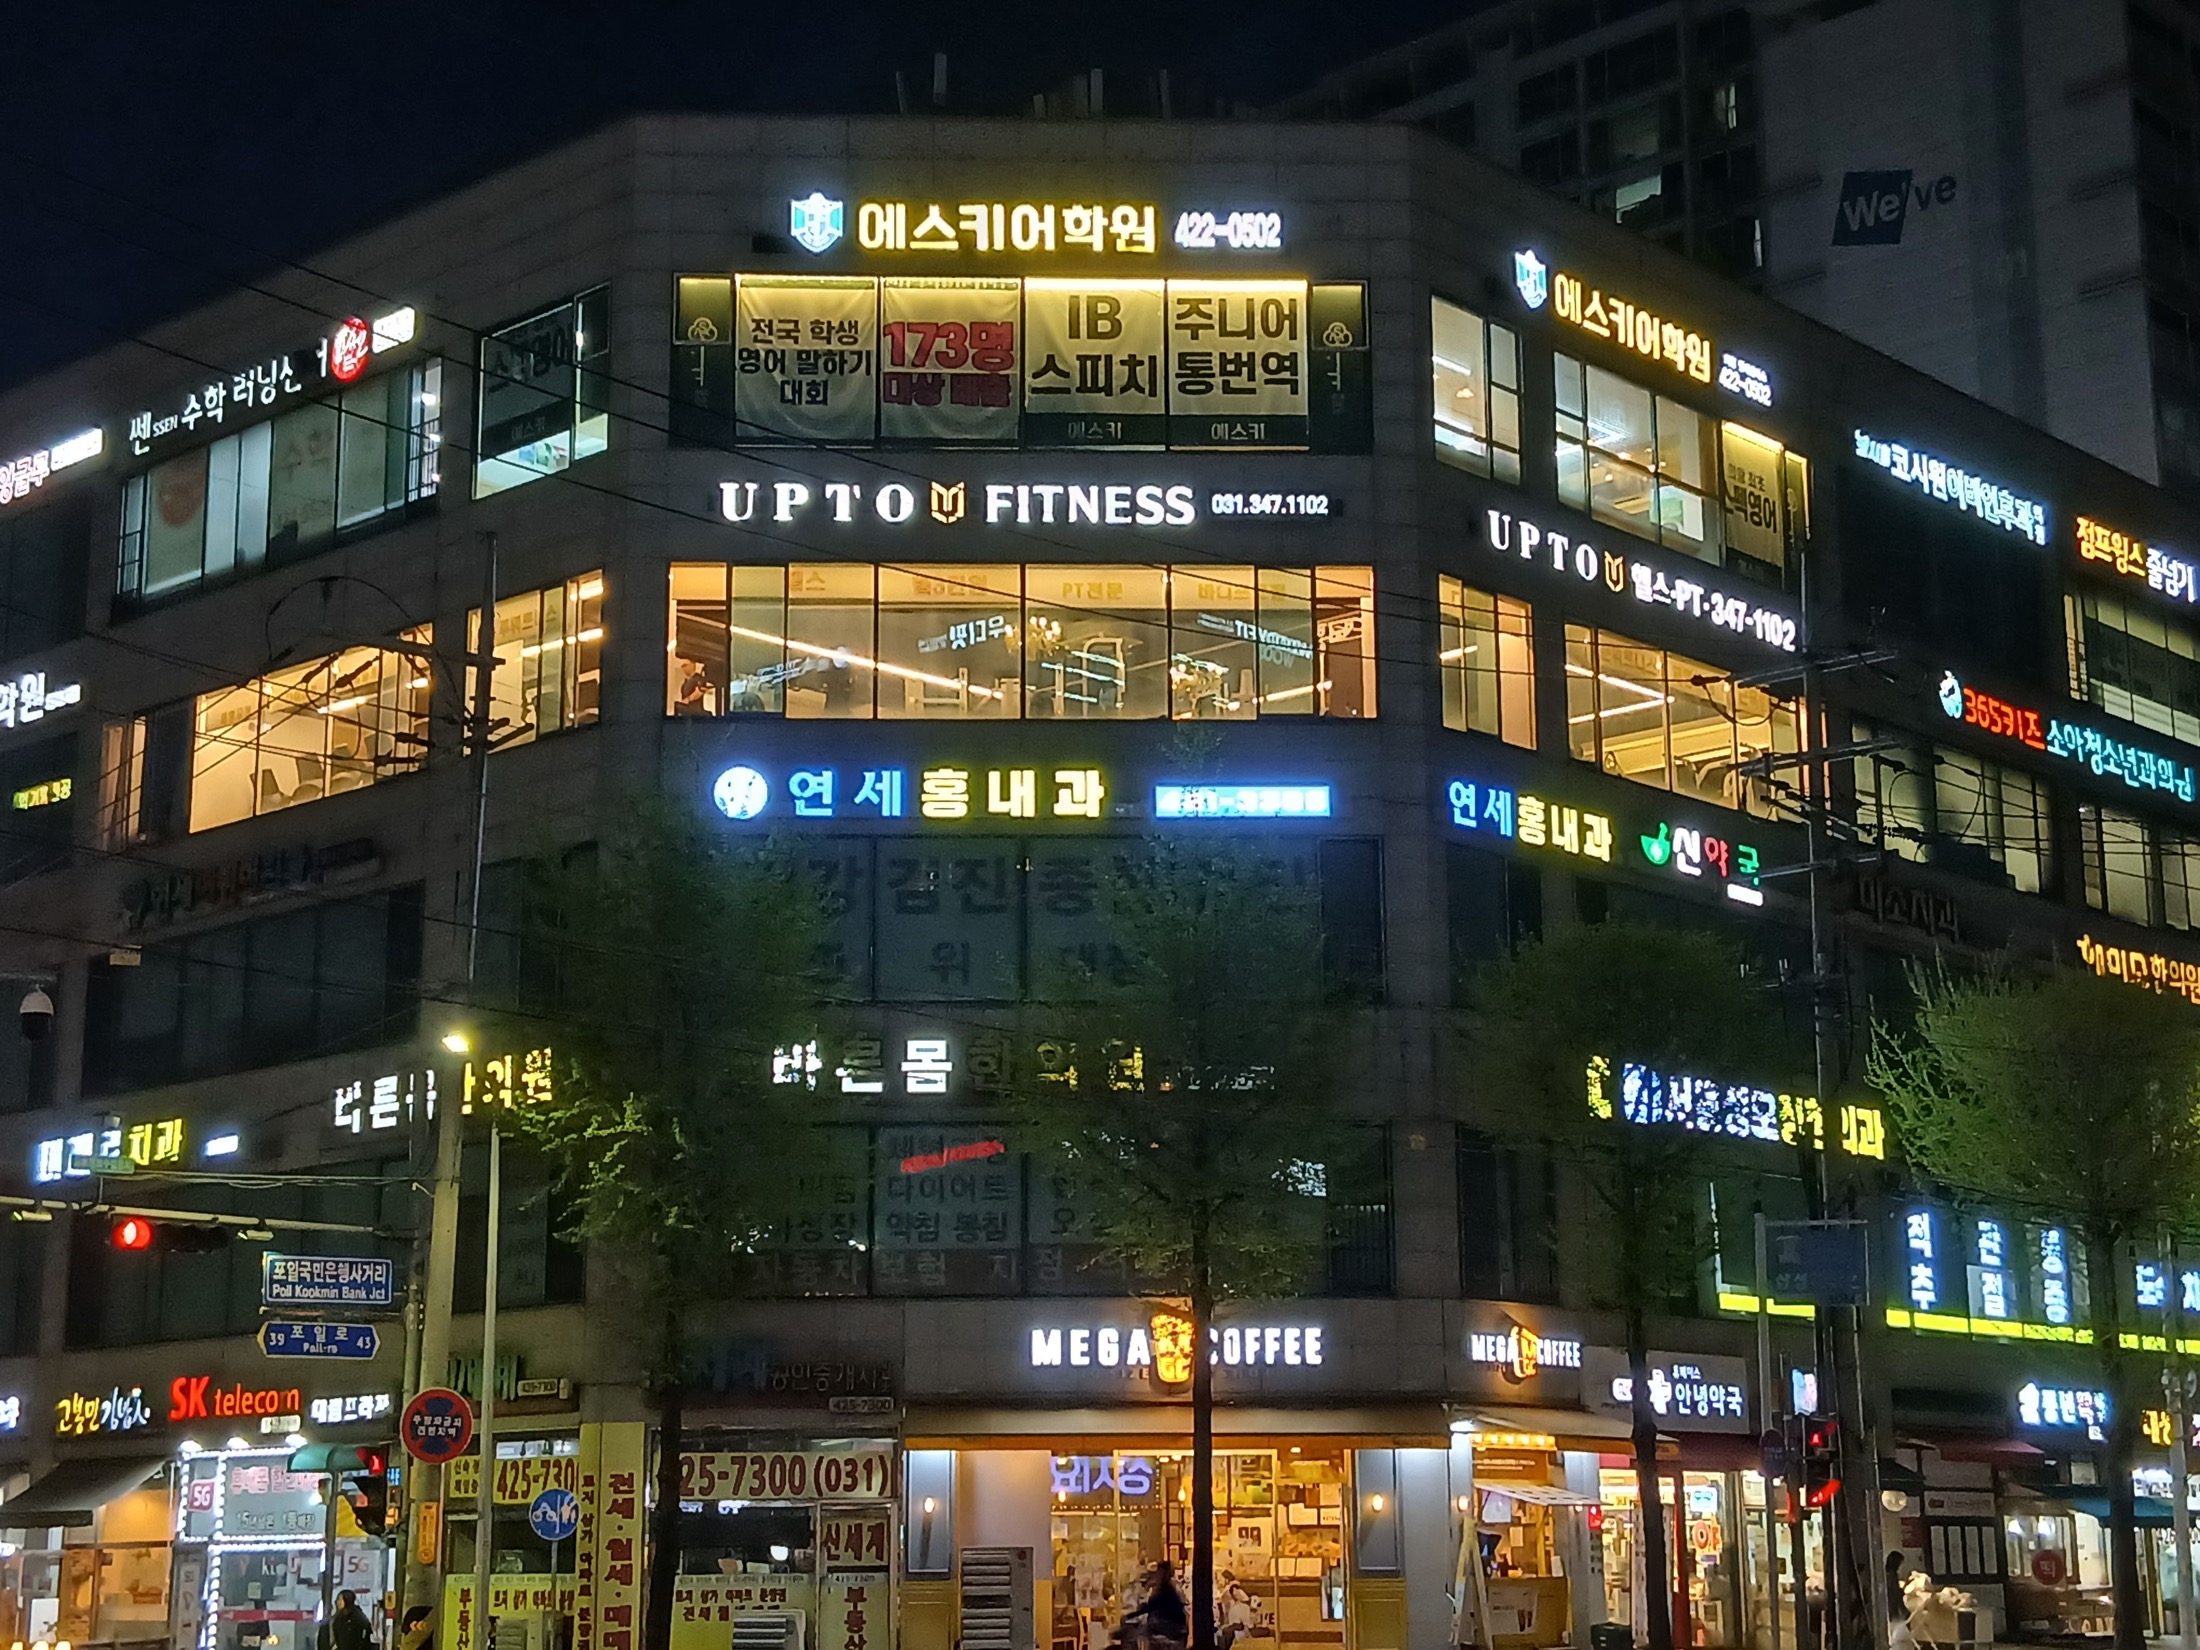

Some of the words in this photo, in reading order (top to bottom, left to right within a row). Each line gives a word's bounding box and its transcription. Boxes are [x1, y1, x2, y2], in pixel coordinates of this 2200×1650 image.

[1843, 175, 1957, 232] We've
[857, 201, 1157, 254] 에스키어학원
[1173, 211, 1283, 249] 422-0502
[751, 317, 801, 346] 전국
[809, 318, 860, 345] 학생
[1067, 295, 1124, 341] IB
[1174, 297, 1299, 342] 주니어
[1554, 273, 1711, 384] 에스키어학원
[738, 349, 786, 376] 영어
[796, 348, 872, 377] 말하기
[883, 321, 1015, 372] 173명
[779, 379, 829, 406] 대회
[1029, 353, 1158, 398] 스피치
[1174, 350, 1300, 396] 통번역
[152, 415, 179, 439] SSEN
[181, 382, 226, 431] 수학
[1210, 421, 1266, 441] 에스키
[986, 483, 1197, 525] FITNESS
[1210, 493, 1329, 517] 031.347.1102
[788, 769, 902, 818] 연세
[920, 769, 1106, 818] 홍내과
[1448, 780, 1514, 838] 연세
[1516, 793, 1613, 864] 홍내과
[272, 1260, 387, 1285] 포일국민은행사거리
[294, 1284, 339, 1299] Kookmin
[341, 1286, 367, 1299] Bank
[369, 1287, 386, 1300] Jct
[269, 1332, 285, 1346] 39
[290, 1325, 349, 1342] 포일로
[356, 1336, 371, 1349] 43
[1030, 1328, 1151, 1366] MEGA
[1471, 1334, 1518, 1363] MEGA
[1536, 1338, 1582, 1368] COFFEE
[169, 1375, 211, 1421] SK
[1674, 1383, 1743, 1417] 안녕약국
[497, 1458, 580, 1500] 425-730
[680, 1453, 807, 1497] 25-7300
[813, 1455, 889, 1497] (031)
[192, 1486, 212, 1507] 5G
[347, 1555, 370, 1574] 5G
